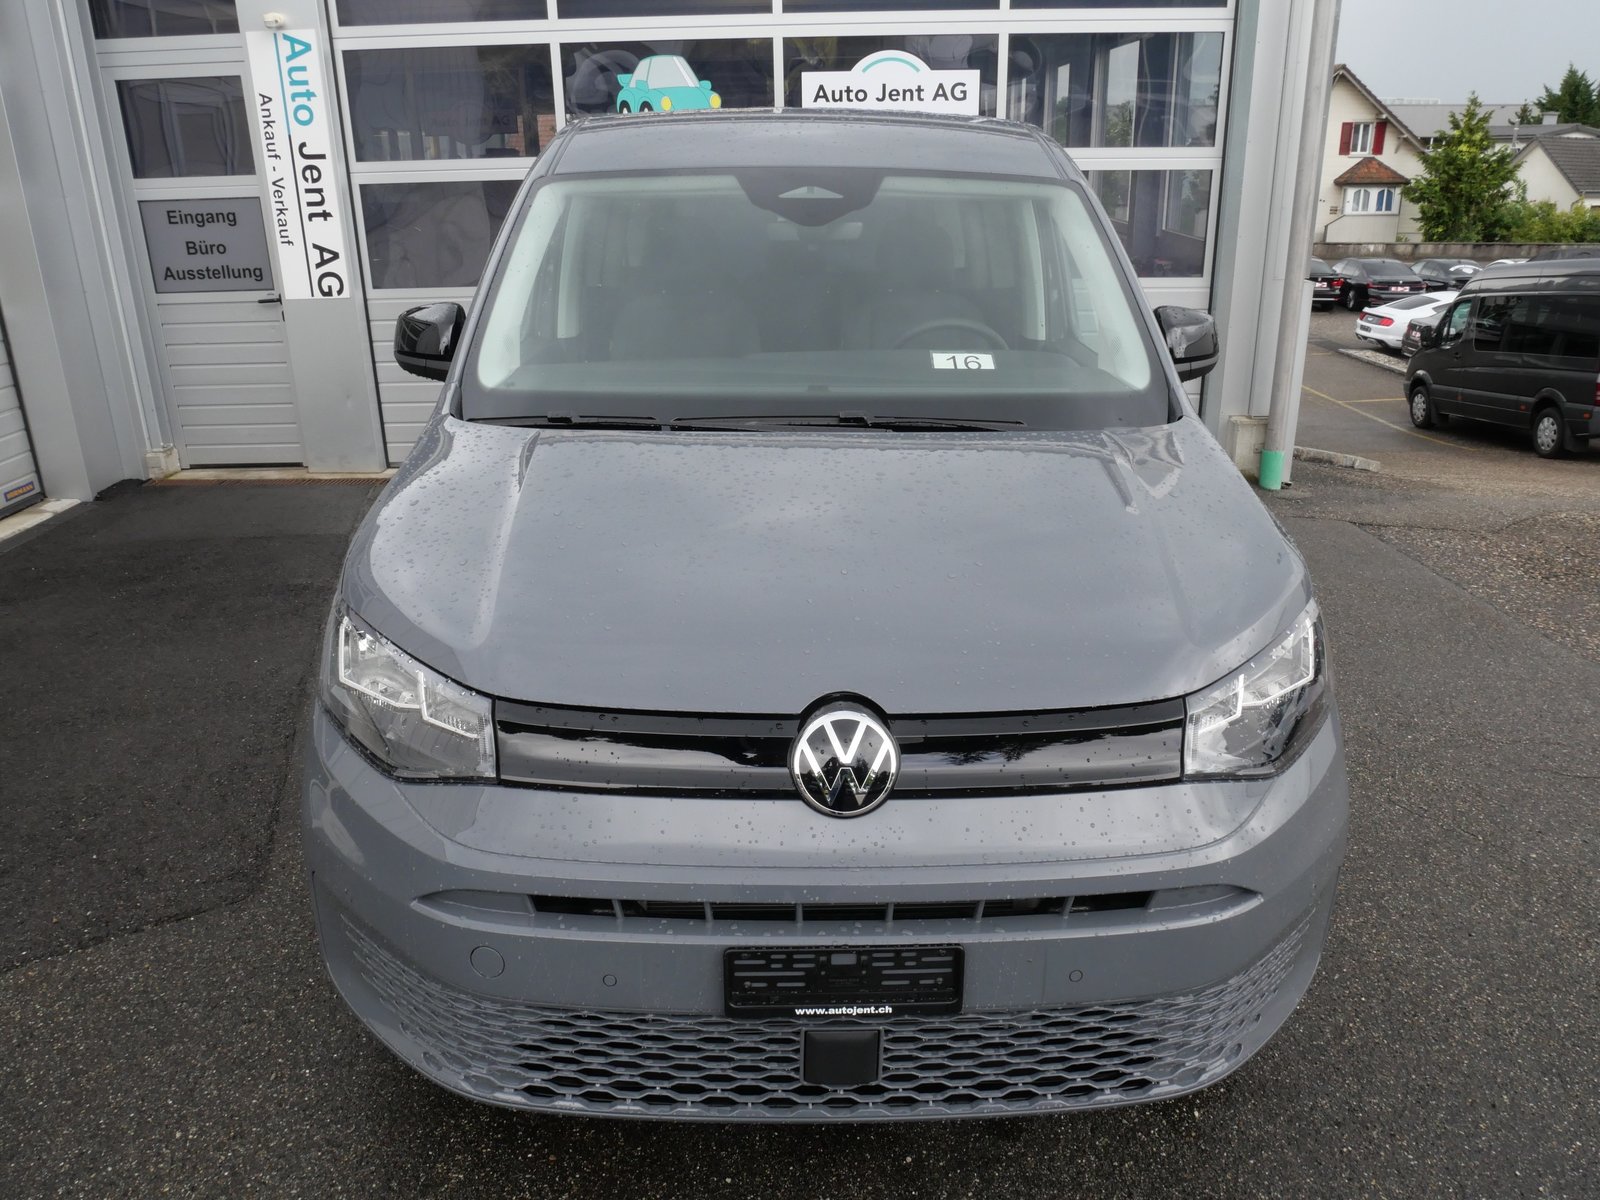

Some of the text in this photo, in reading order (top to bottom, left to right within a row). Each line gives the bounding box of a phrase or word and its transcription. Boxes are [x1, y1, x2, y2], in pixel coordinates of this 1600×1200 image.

[813, 82, 968, 103] Auto Jent AG
[259, 92, 281, 160] Ankauf
[271, 177, 294, 246] Verkauf
[282, 33, 344, 297] Auto Jent AG
[166, 209, 238, 228] Eingang
[185, 240, 227, 256] Büro
[163, 264, 264, 282] Ausstellung
[946, 355, 982, 370] 16
[800, 716, 892, 808] VW
[794, 1005, 893, 1016] www.autojent.ch
